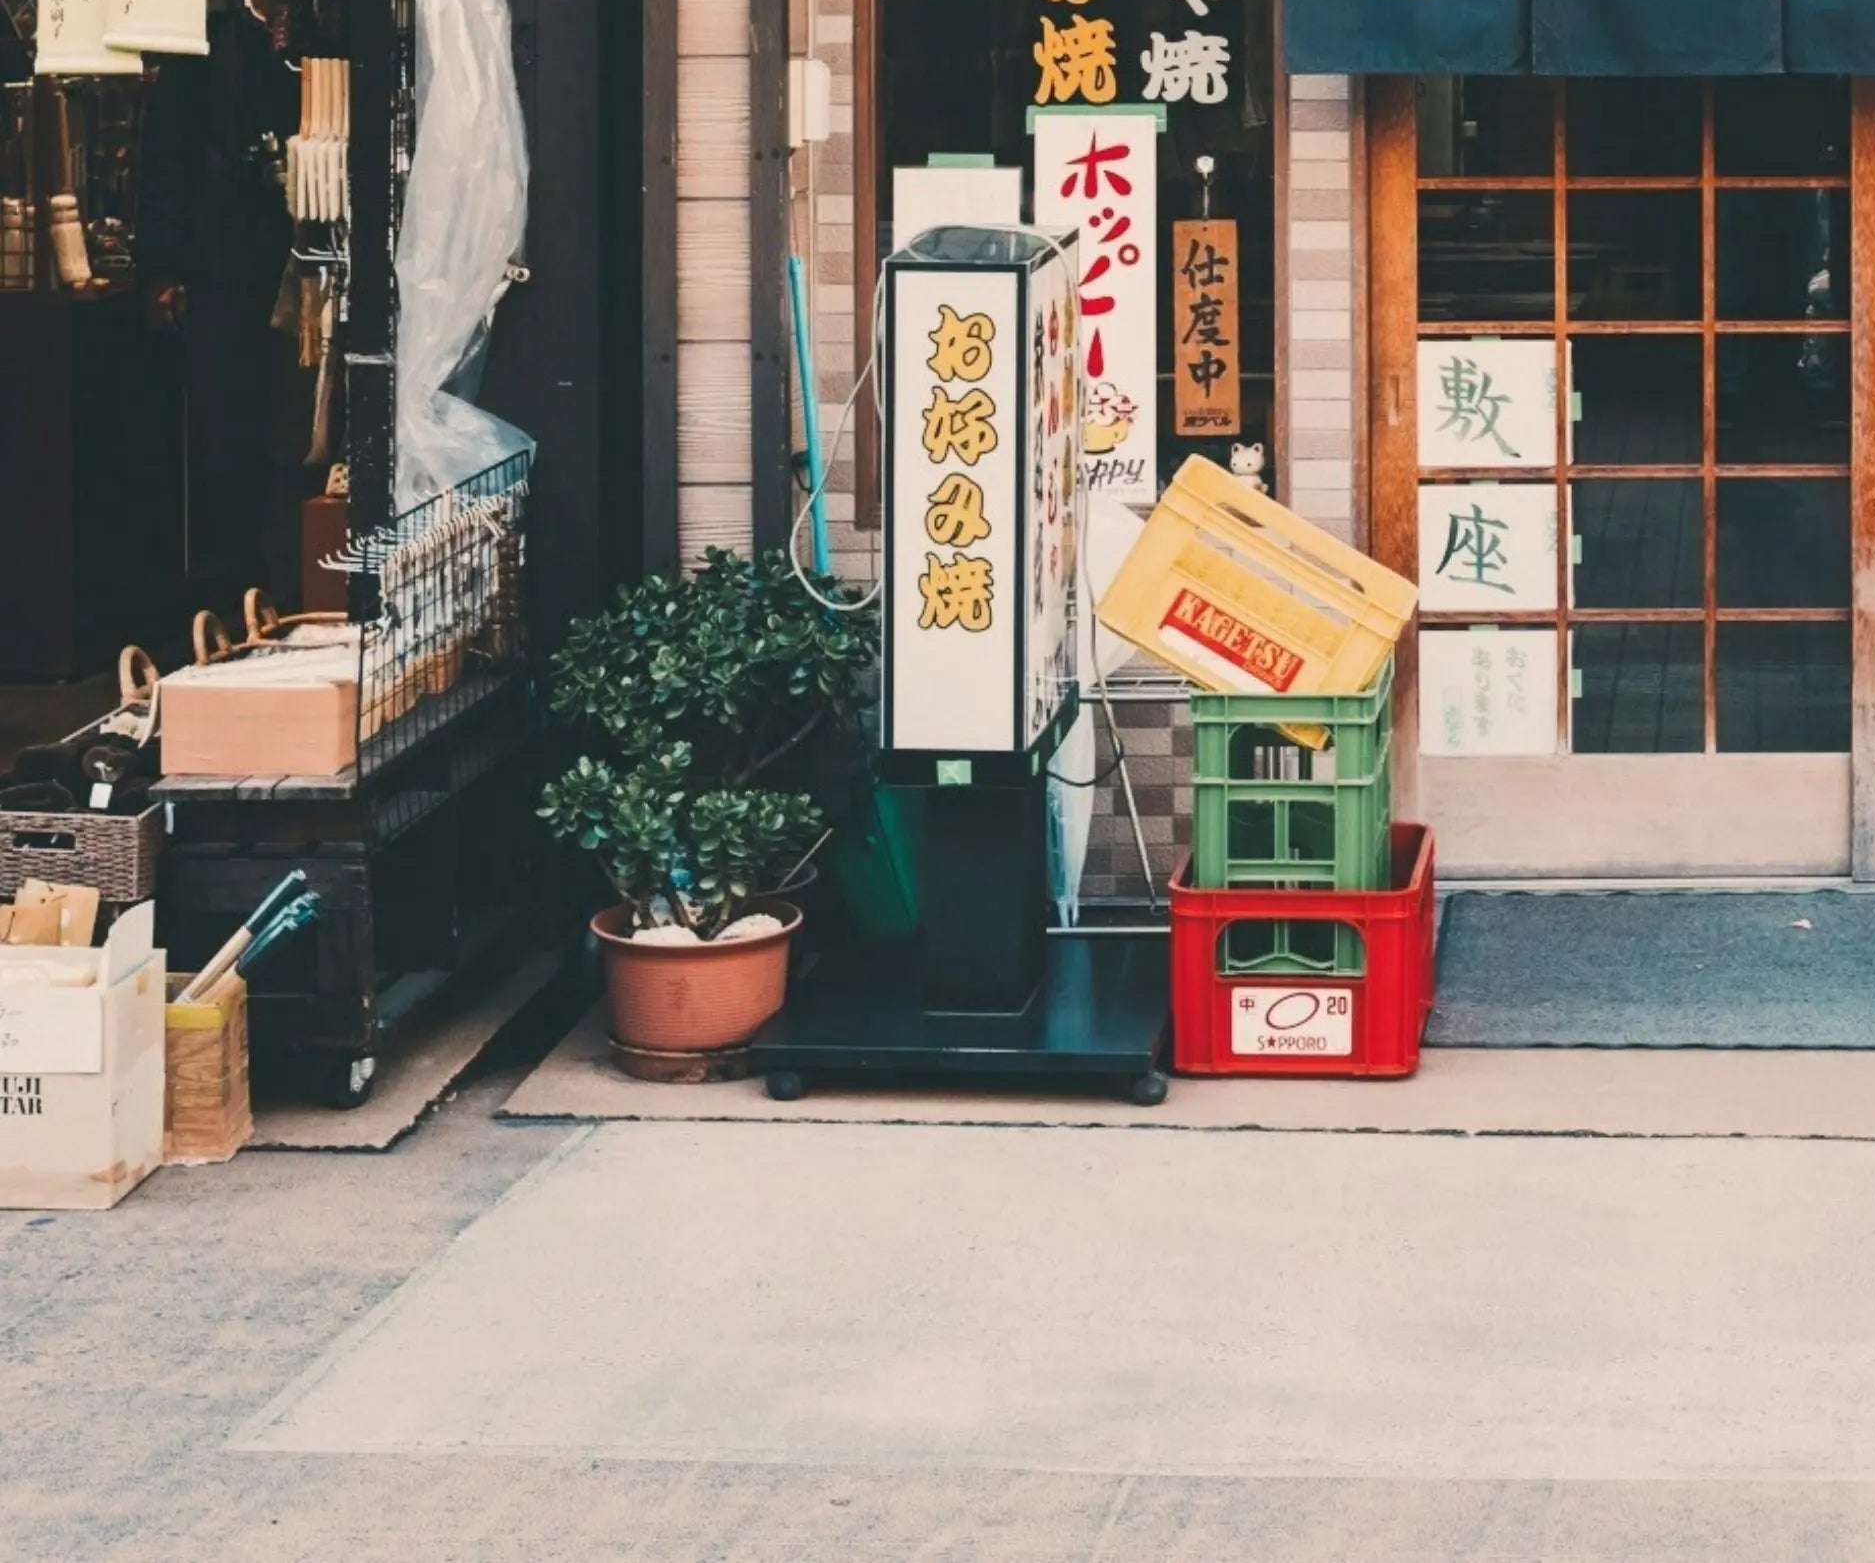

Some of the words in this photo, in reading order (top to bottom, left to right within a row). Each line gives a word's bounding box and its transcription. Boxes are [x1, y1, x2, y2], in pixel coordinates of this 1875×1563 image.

[1061, 130, 1140, 378] ホッピー
[1181, 239, 1230, 399] 仕度中
[918, 305, 999, 633] お好み焼
[1173, 596, 1297, 678] KAGETSU
[1239, 997, 1255, 1011] 中
[1327, 996, 1347, 1015] 20
